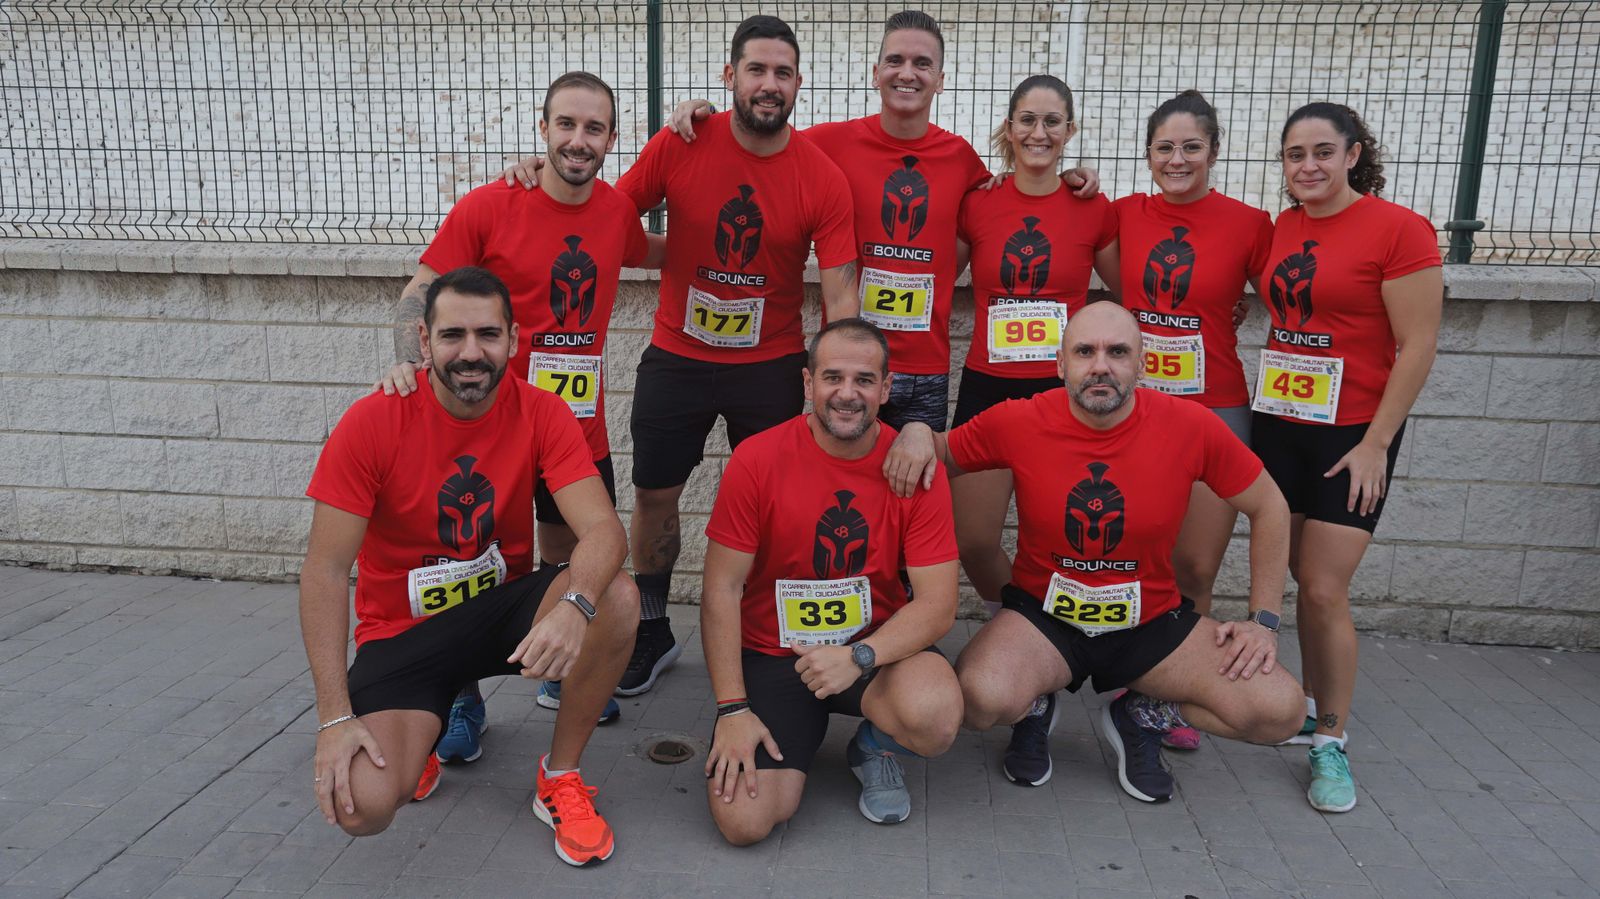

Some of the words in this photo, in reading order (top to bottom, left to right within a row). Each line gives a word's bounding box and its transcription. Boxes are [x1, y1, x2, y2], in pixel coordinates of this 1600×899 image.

[864, 245, 932, 261] DBOUNCE
[699, 268, 765, 286] DBOUNCE
[694, 296, 710, 307] ENTRE
[876, 289, 914, 312] 21
[695, 308, 750, 332] 177
[1006, 320, 1046, 342] 96
[534, 334, 596, 345] DBOUNC
[1145, 352, 1181, 376] 95
[551, 374, 588, 398] 70
[1273, 372, 1314, 398] 43
[418, 577, 442, 586] ENTRE
[454, 564, 489, 580] CIUDADES
[423, 570, 495, 610] 315
[815, 589, 851, 597] CIUDADES
[1057, 583, 1077, 596] ENTRE
[799, 601, 846, 626] 33
[1054, 595, 1127, 622] 223
